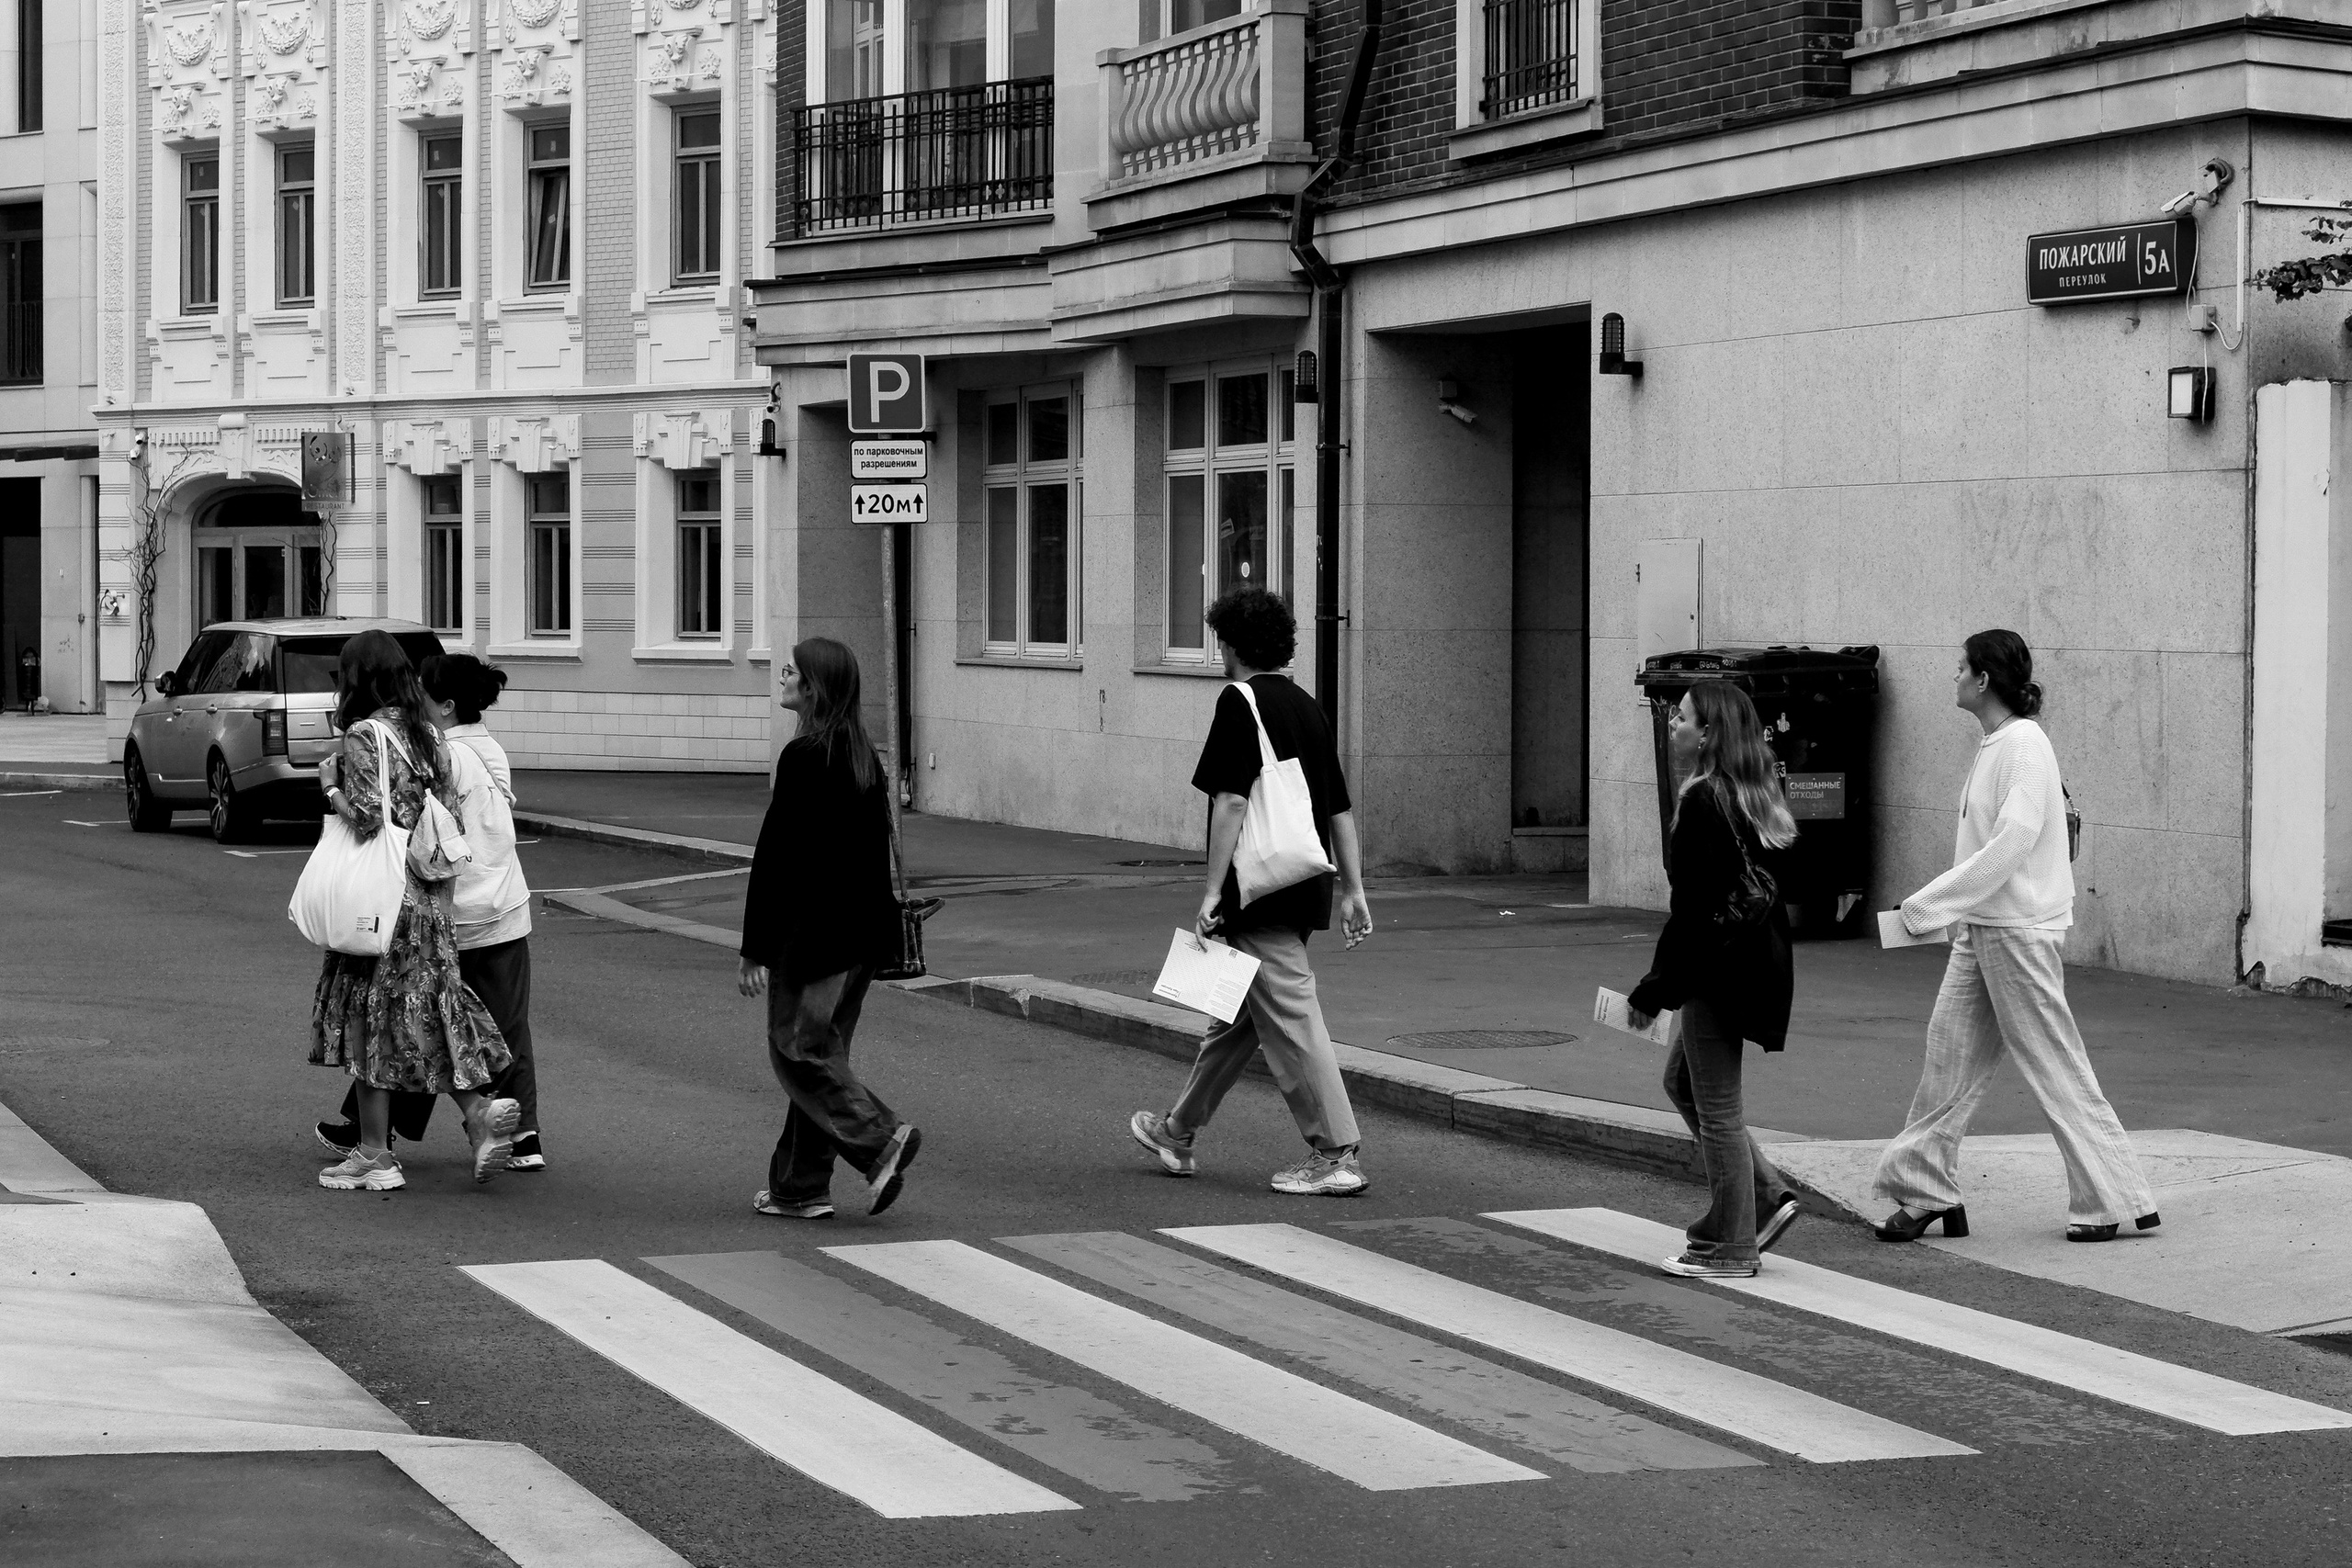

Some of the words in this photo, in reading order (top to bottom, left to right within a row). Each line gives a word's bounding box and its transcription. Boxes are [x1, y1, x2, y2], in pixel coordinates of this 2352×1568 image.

[2039, 235, 2126, 270] ПОЖАРСКИЙ
[2144, 241, 2171, 275] 5А
[2059, 273, 2107, 288] ПЕРЕУЛОК
[869, 361, 910, 423] P
[866, 447, 923, 457] парковочным
[861, 459, 917, 470] разрешениям
[1789, 781, 1841, 790] СМЕШАННЫЕ
[1790, 791, 1824, 800] ОТХОДЫ
